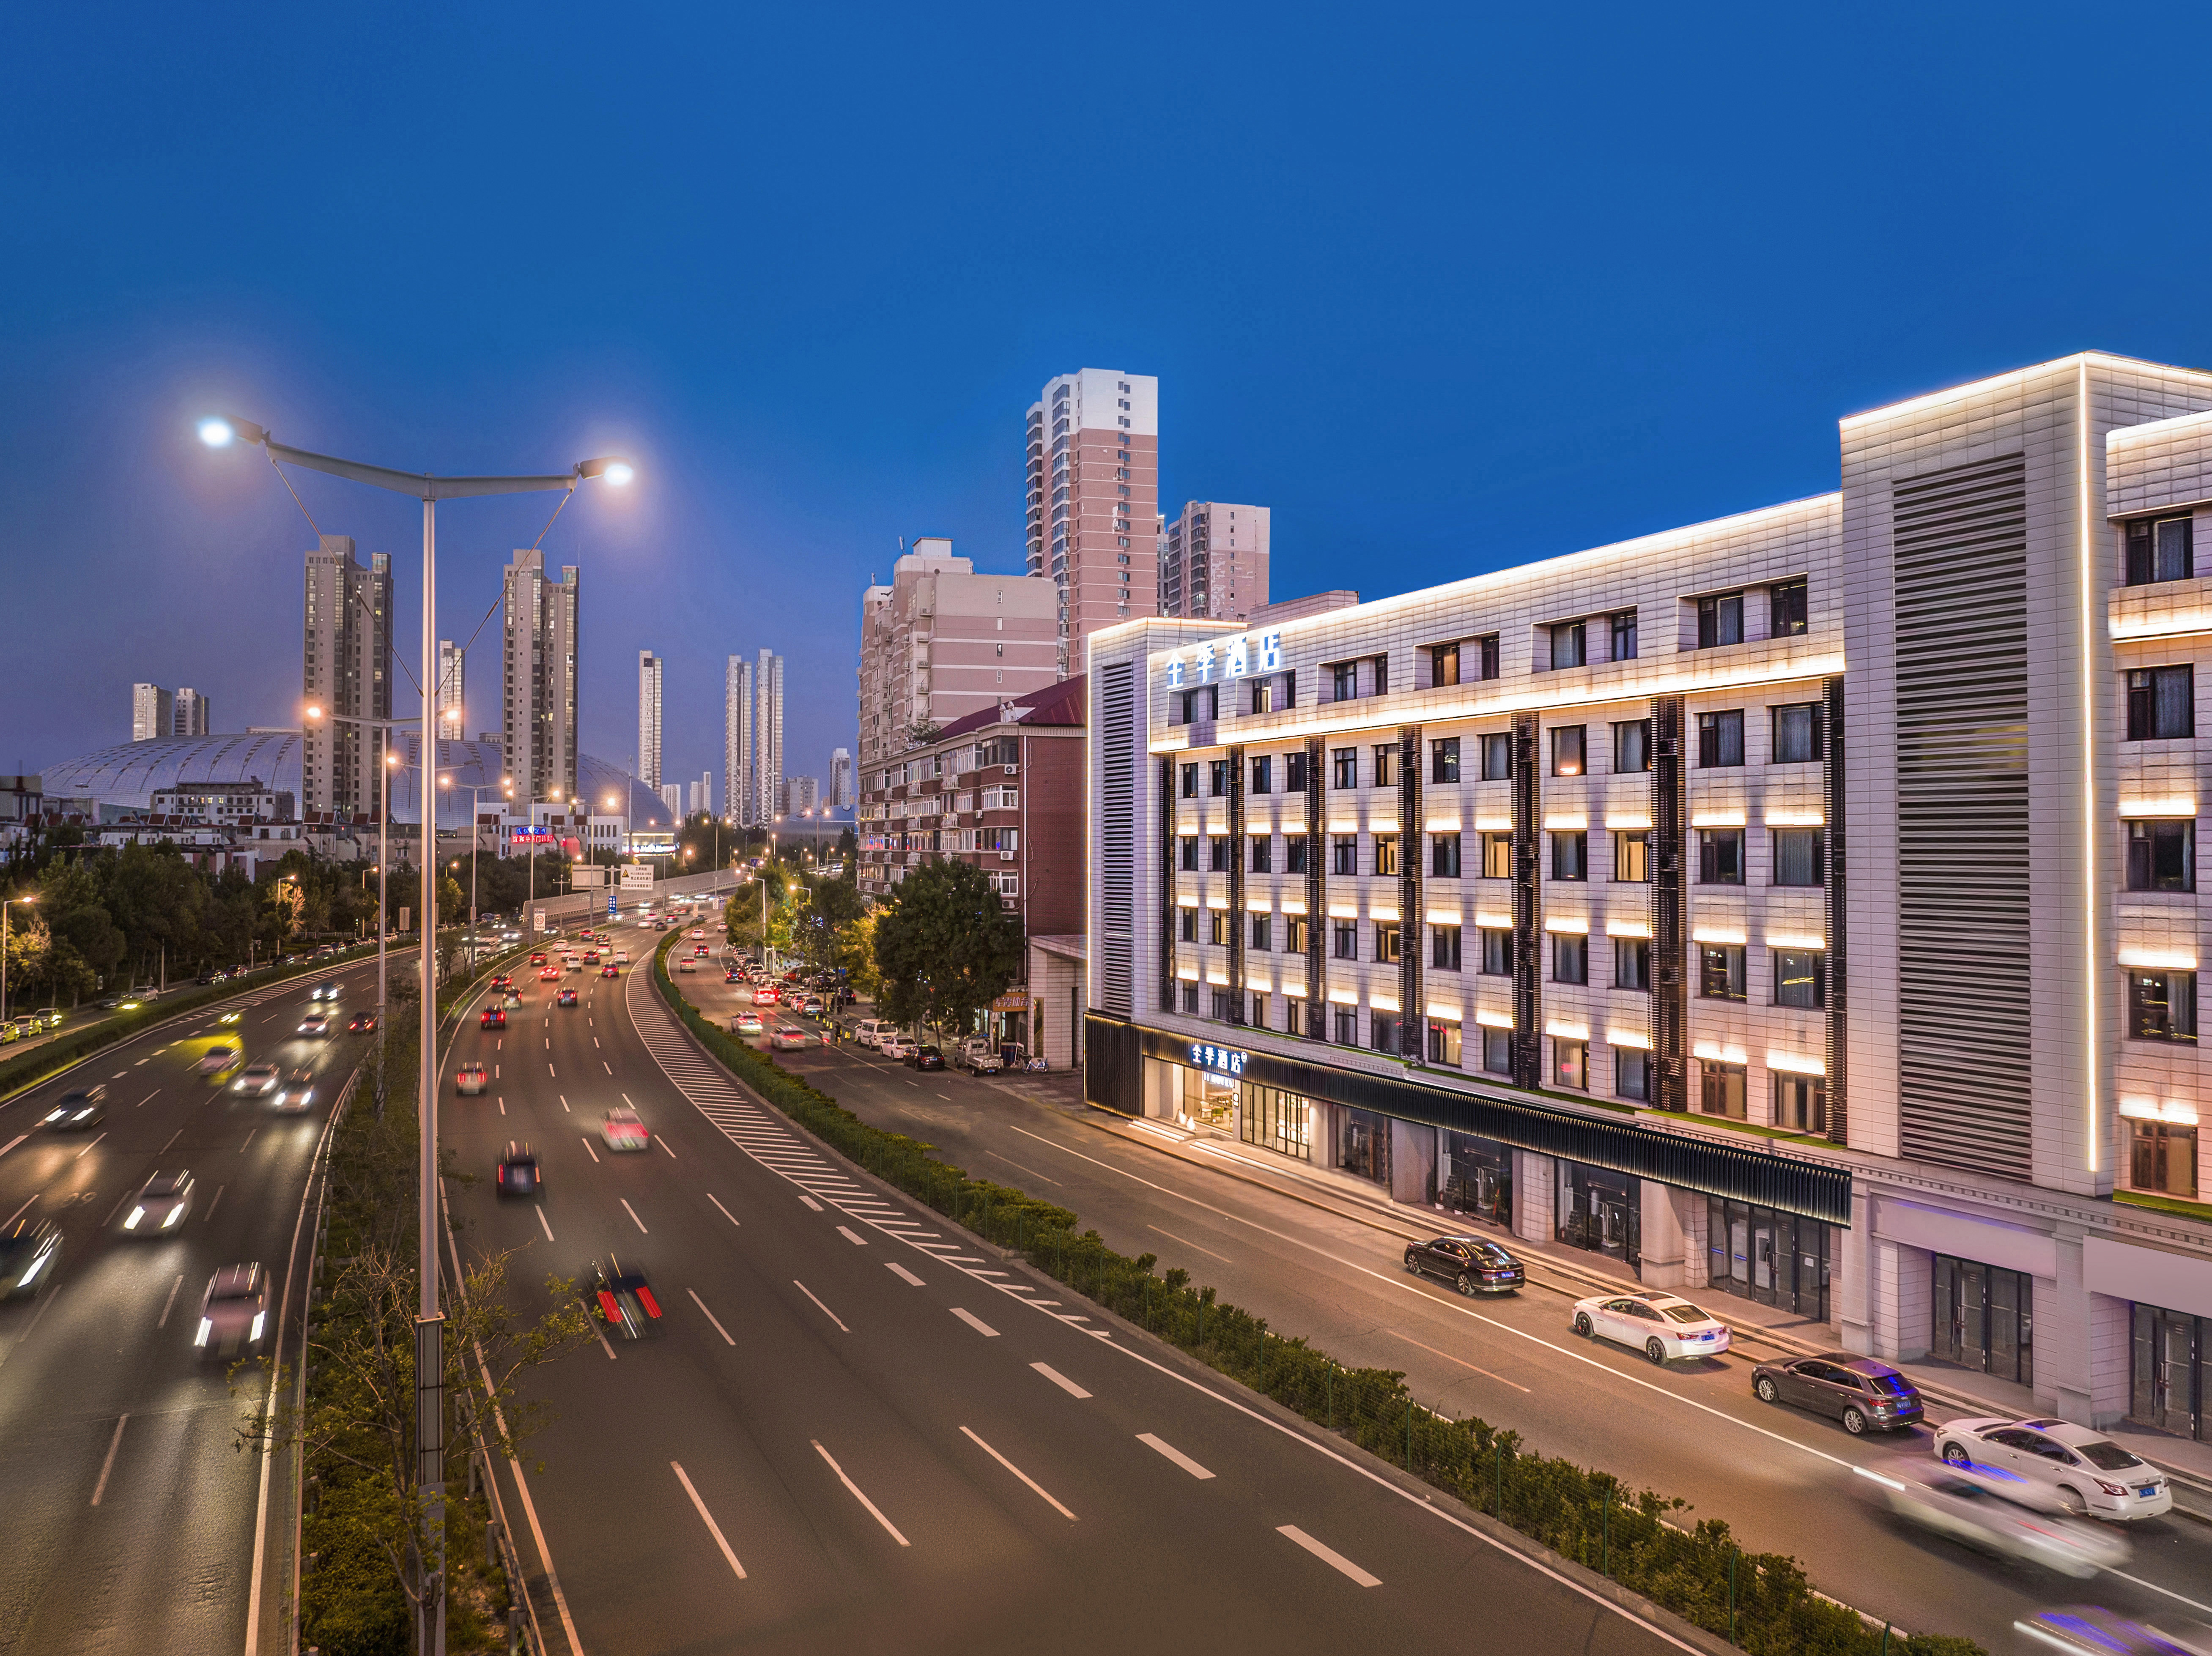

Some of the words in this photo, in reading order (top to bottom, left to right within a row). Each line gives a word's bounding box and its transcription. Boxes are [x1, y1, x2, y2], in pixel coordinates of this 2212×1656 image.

[1166, 632, 1280, 689] 全季酒店
[1192, 1044, 1240, 1073] 全季酒店
